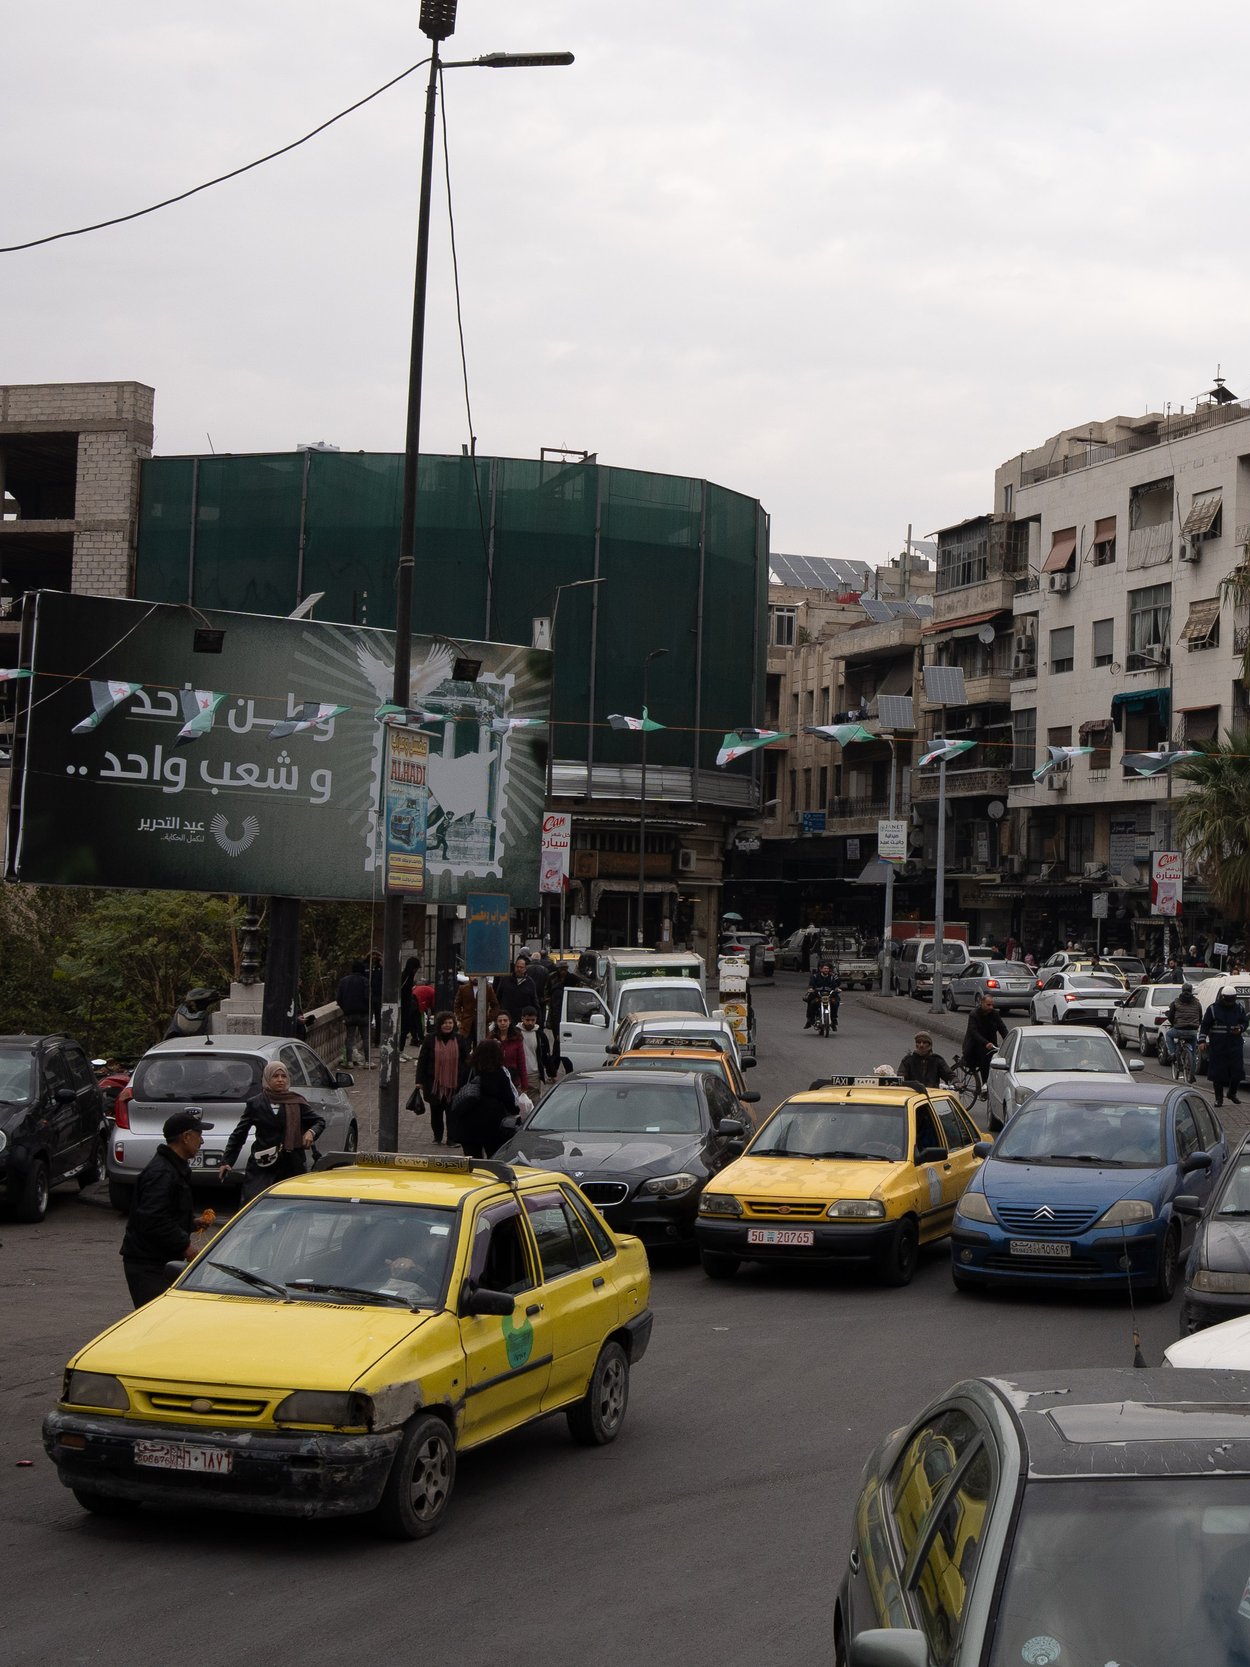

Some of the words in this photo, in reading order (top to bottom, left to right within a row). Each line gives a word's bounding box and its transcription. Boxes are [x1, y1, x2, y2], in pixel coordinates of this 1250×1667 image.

[99, 744, 187, 793] واحد
[199, 750, 299, 795] شعب
[391, 758, 427, 786] ALHADI
[137, 816, 180, 832] التحرير
[183, 817, 205, 833] عيد
[543, 815, 566, 832] Can
[541, 837, 568, 850] سيارة
[1158, 854, 1178, 867] Can
[1156, 871, 1181, 881] سيارة
[832, 1076, 848, 1085] TAXI
[751, 1230, 764, 1242] 50
[777, 1232, 810, 1244] 20765
